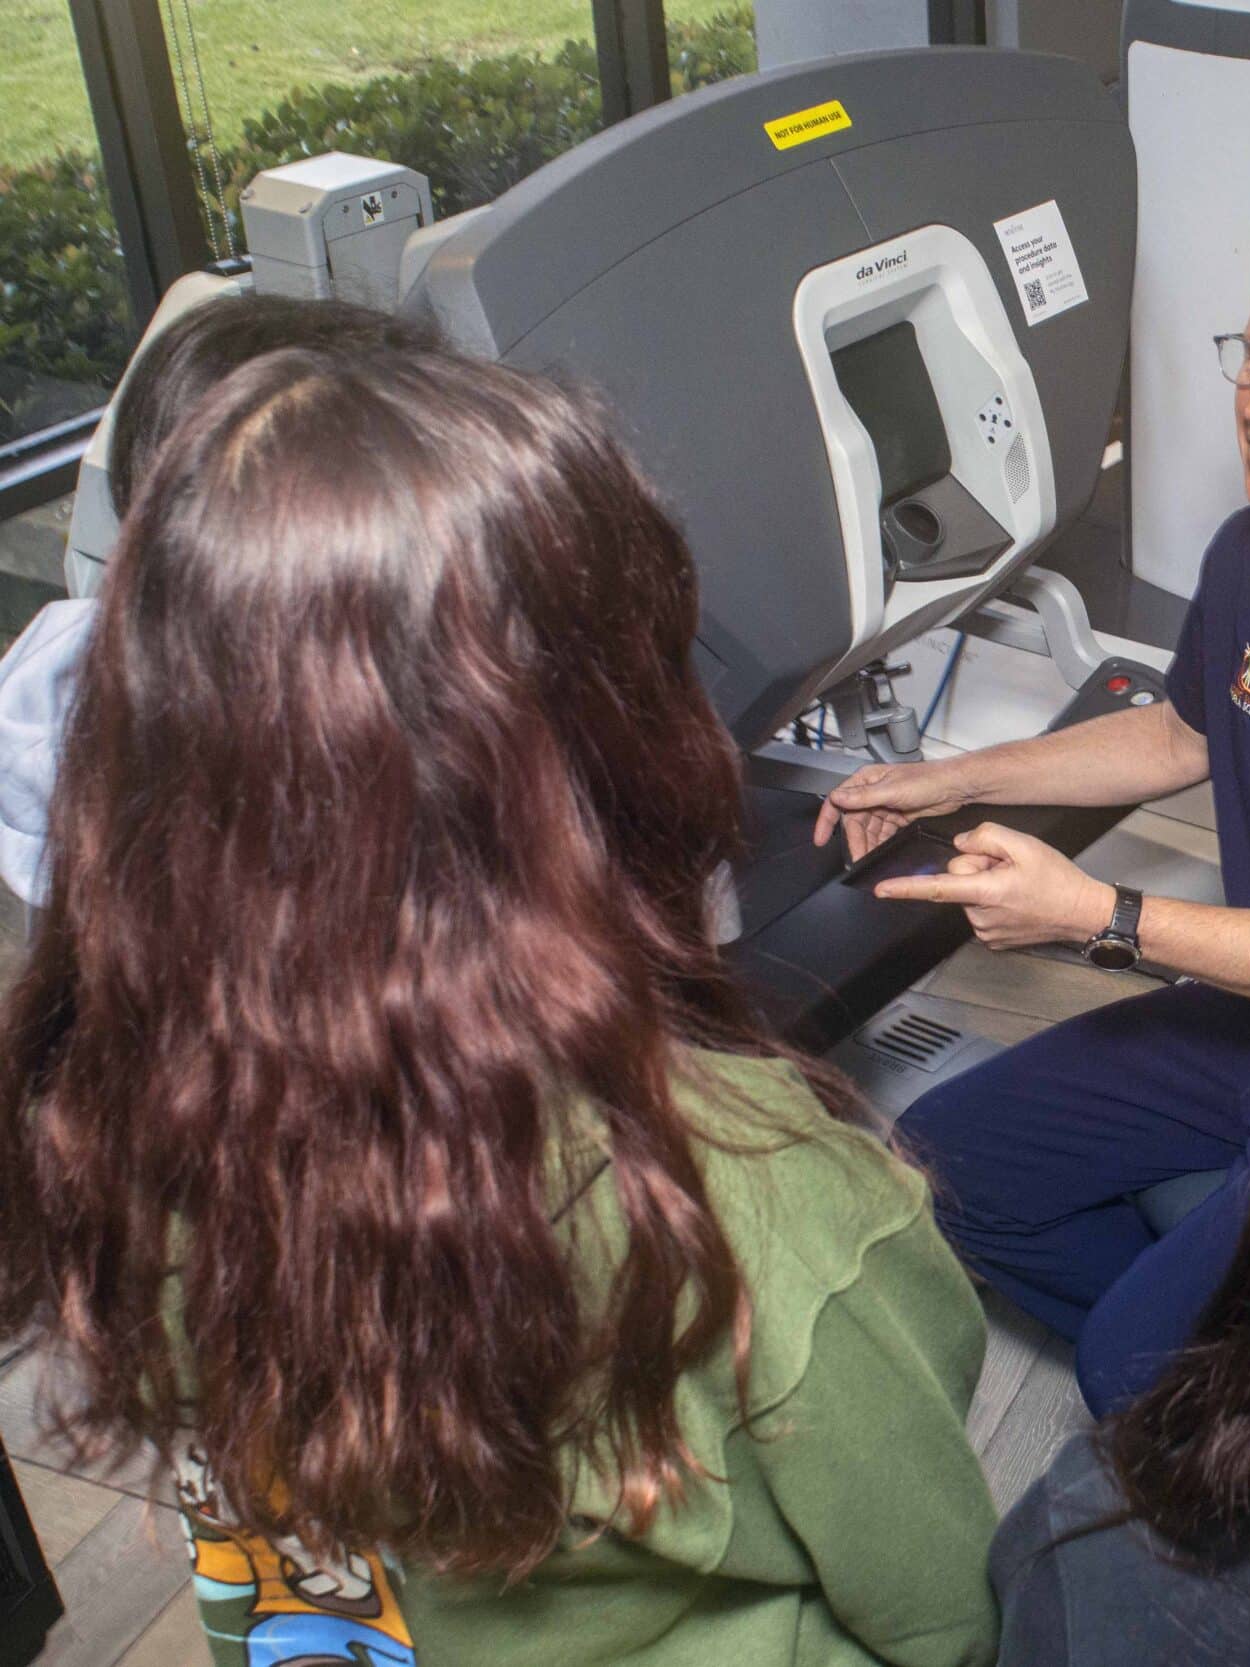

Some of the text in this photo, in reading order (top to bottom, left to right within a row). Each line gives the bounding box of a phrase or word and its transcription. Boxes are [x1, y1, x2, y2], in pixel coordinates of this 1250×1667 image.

[774, 110, 842, 140] NOT FOR HUMAN USE
[1011, 235, 1044, 253] Access your
[856, 265, 874, 281] da
[875, 249, 908, 273] Vinci
[1014, 247, 1043, 267] procedure
[1018, 255, 1053, 274] and insights
